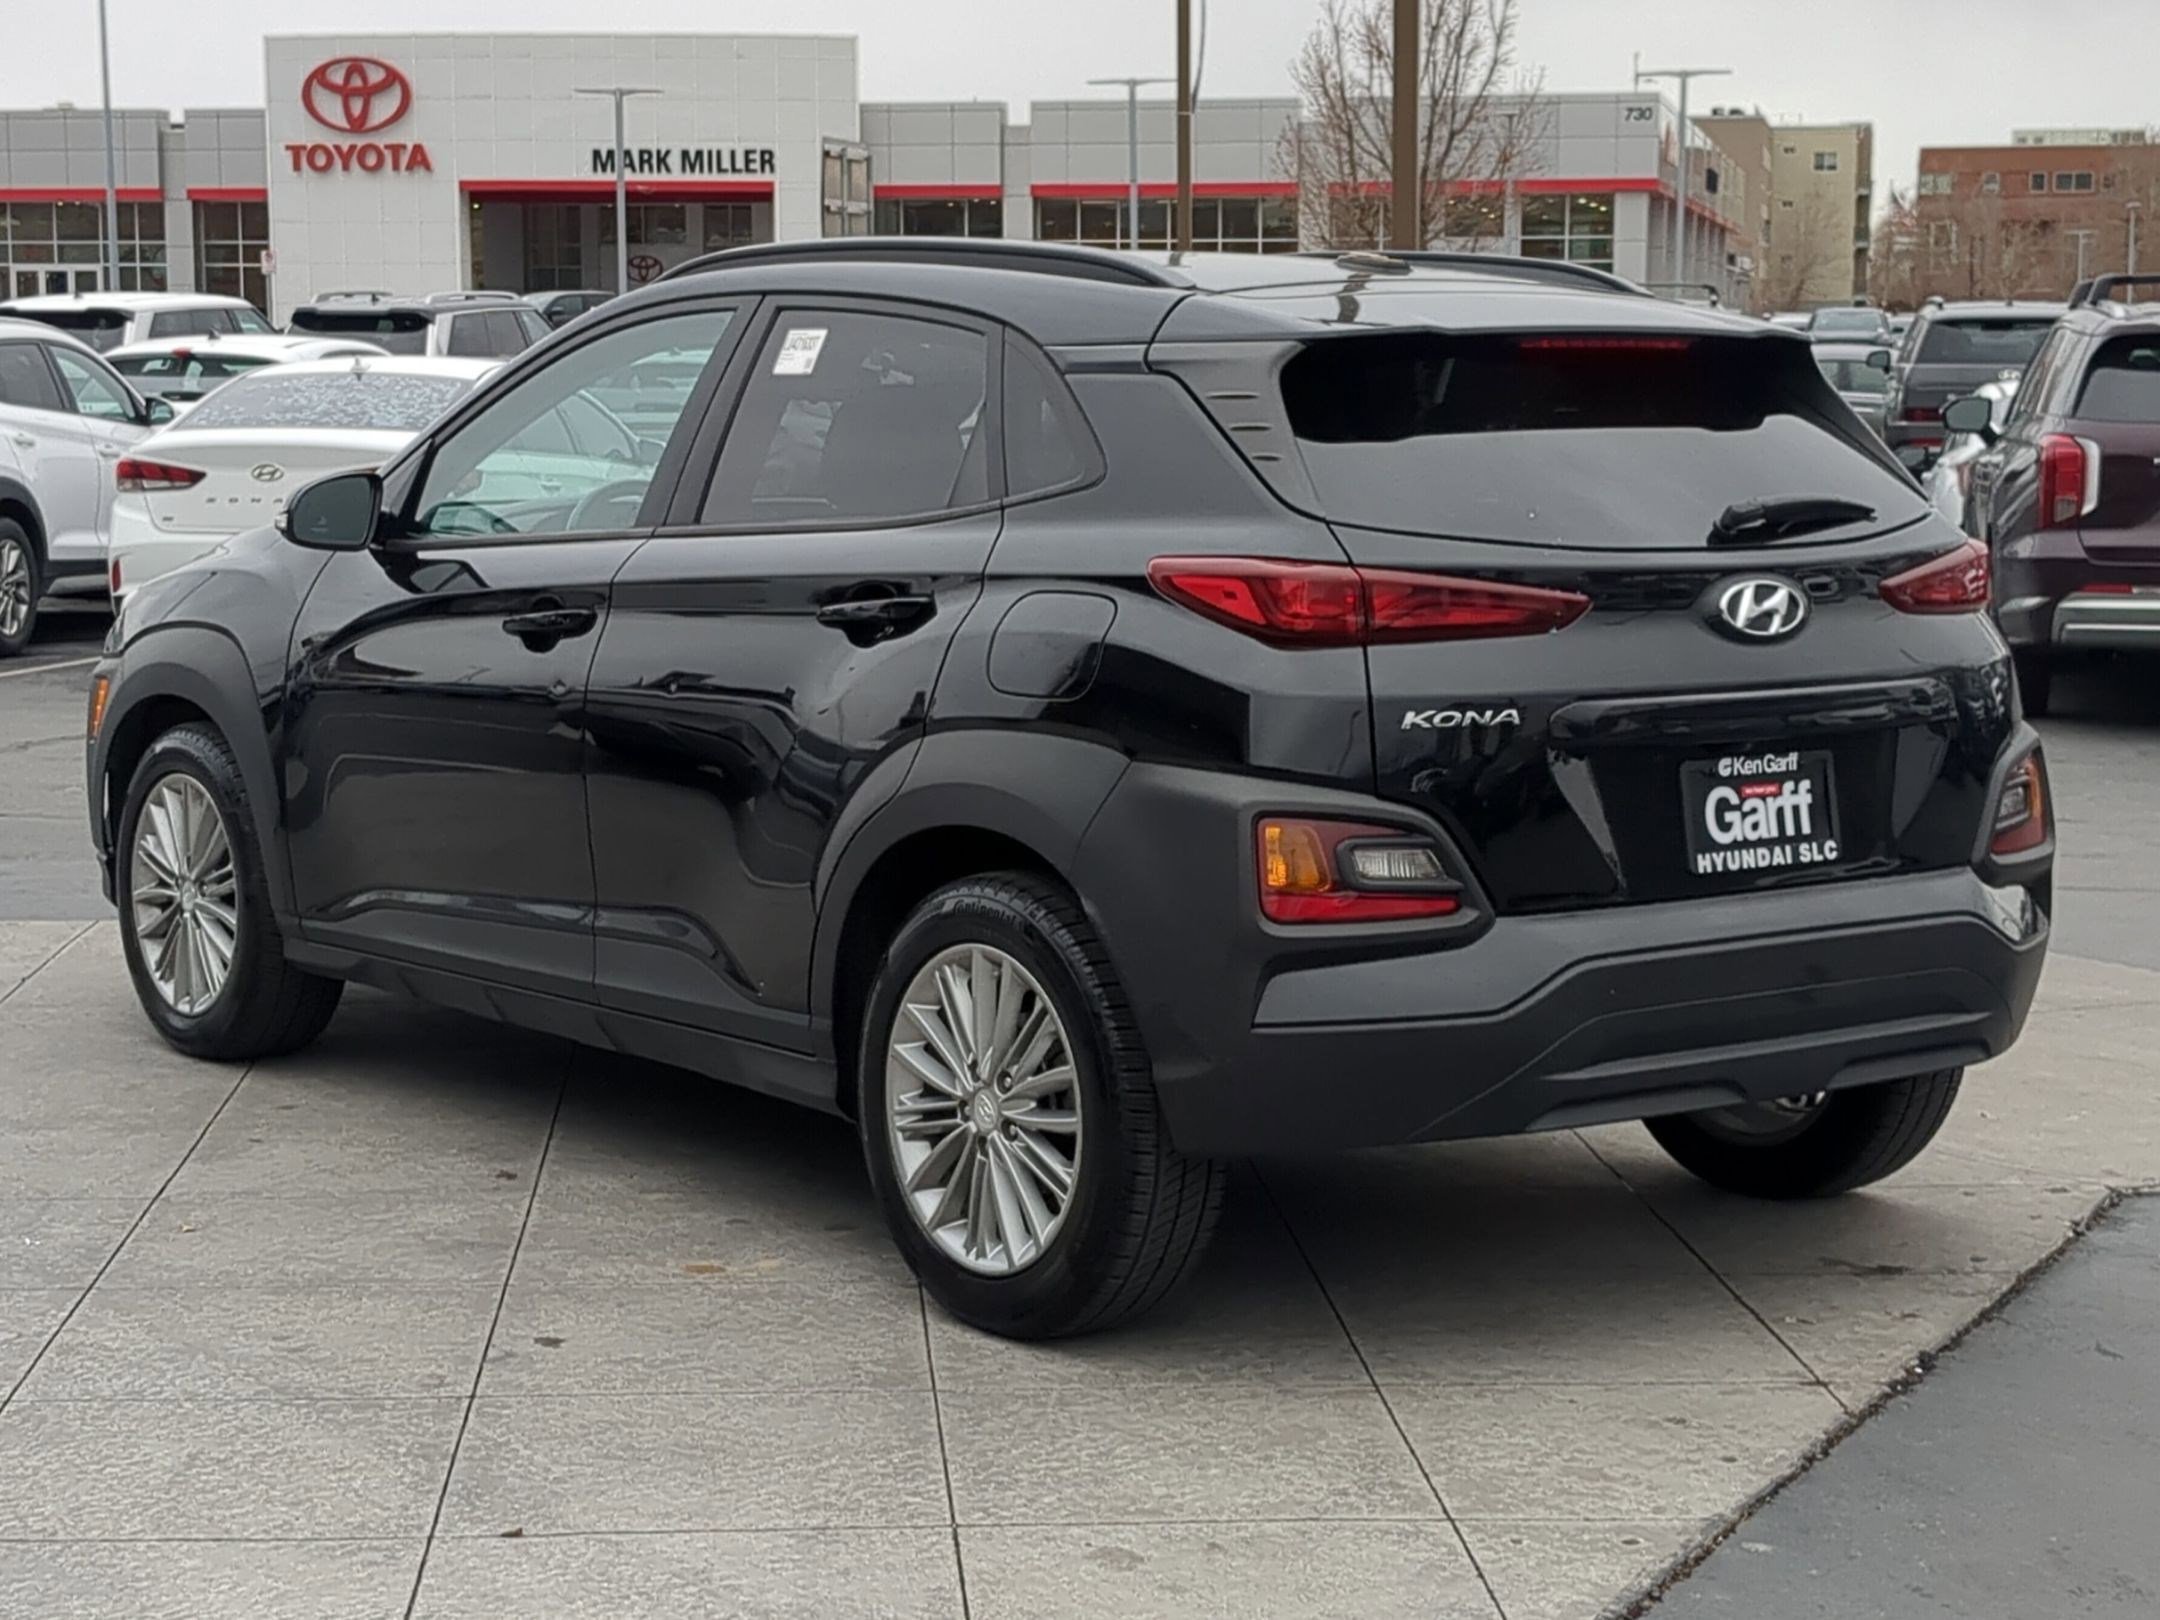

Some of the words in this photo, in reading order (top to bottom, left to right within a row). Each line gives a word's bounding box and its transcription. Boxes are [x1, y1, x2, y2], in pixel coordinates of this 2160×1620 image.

[1625, 107, 1653, 122] 730
[285, 143, 433, 173] TOYOTA
[592, 148, 672, 174] MARK
[680, 148, 775, 174] MILLER
[1401, 709, 1520, 730] KONA
[1733, 756, 1763, 776] Ken
[1763, 752, 1799, 773] Garff
[1704, 779, 1813, 845] Garff
[1697, 845, 1793, 874] HYUNDAI
[1798, 840, 1838, 863] SLC
[954, 899, 1018, 925] Continental
